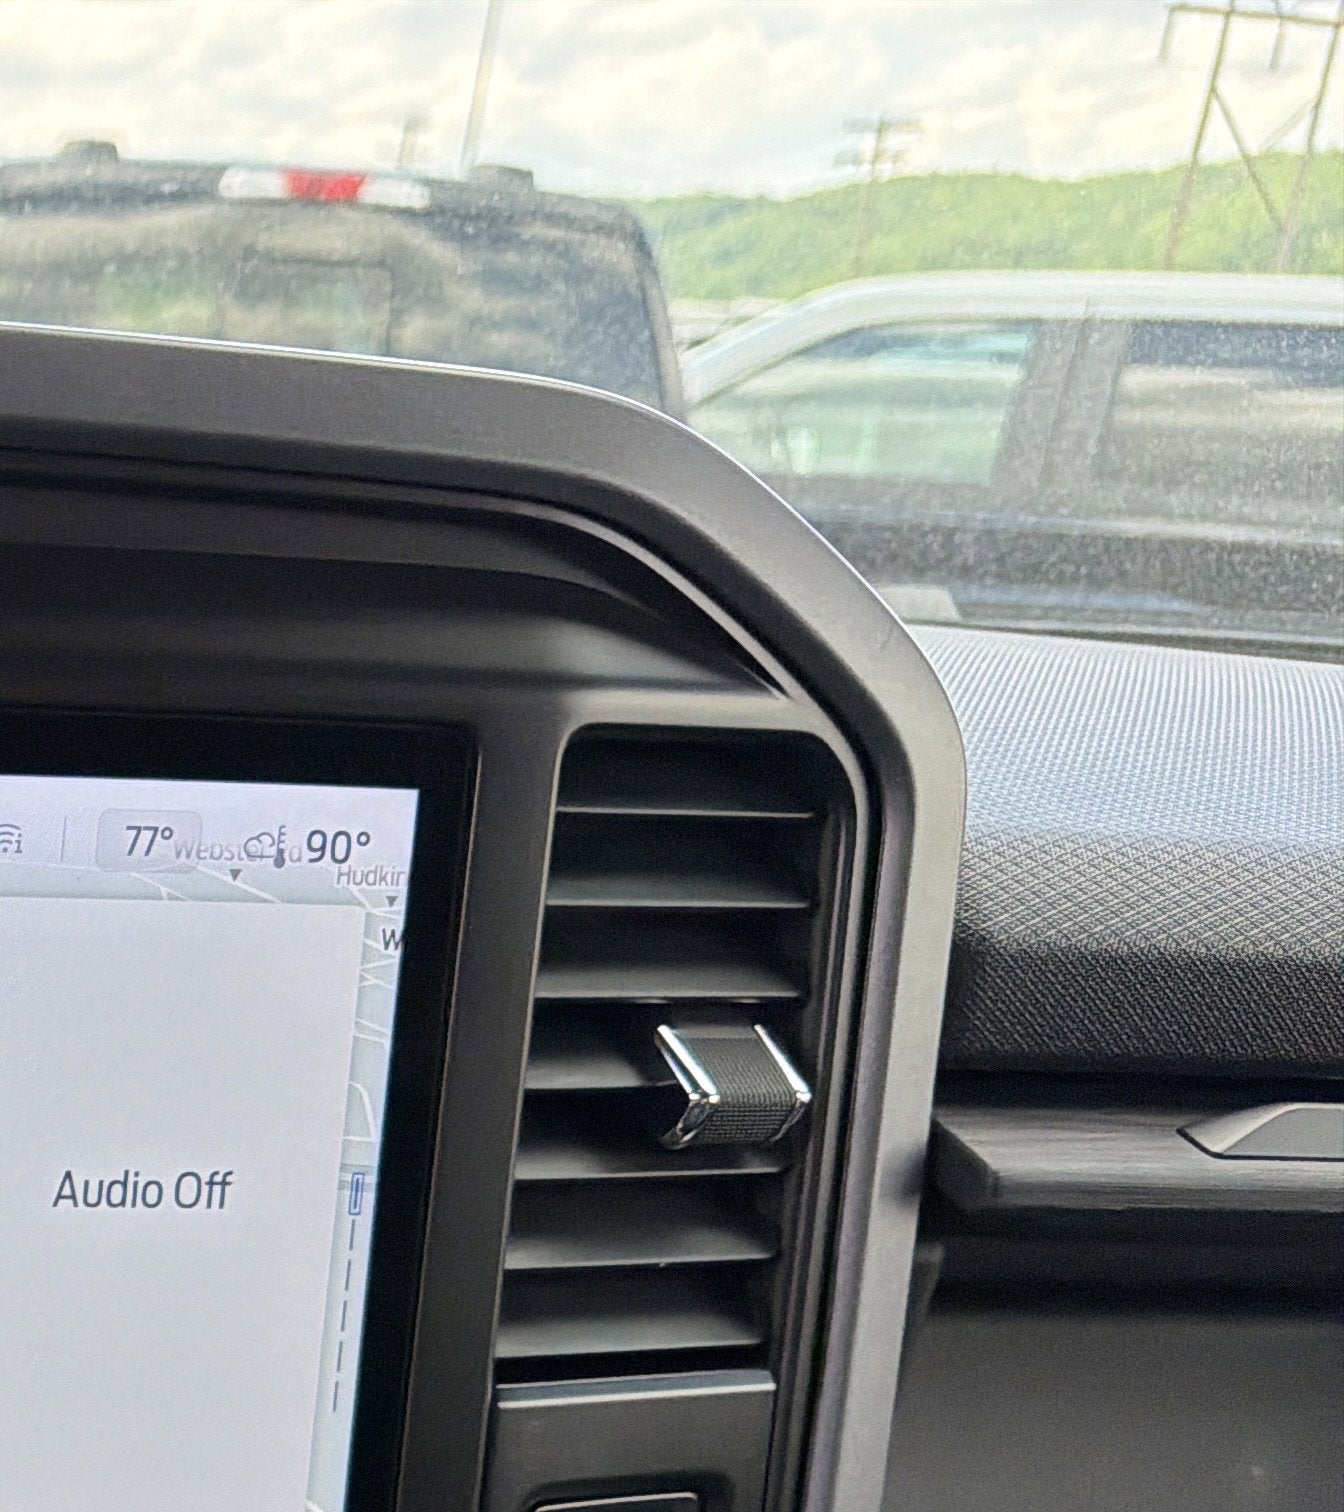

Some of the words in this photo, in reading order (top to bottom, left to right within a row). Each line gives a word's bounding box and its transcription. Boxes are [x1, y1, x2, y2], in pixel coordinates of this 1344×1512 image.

[124, 825, 174, 858] 77°
[306, 829, 371, 865] 90°
[53, 1171, 164, 1209] Audio
[173, 1171, 234, 1209] Off
